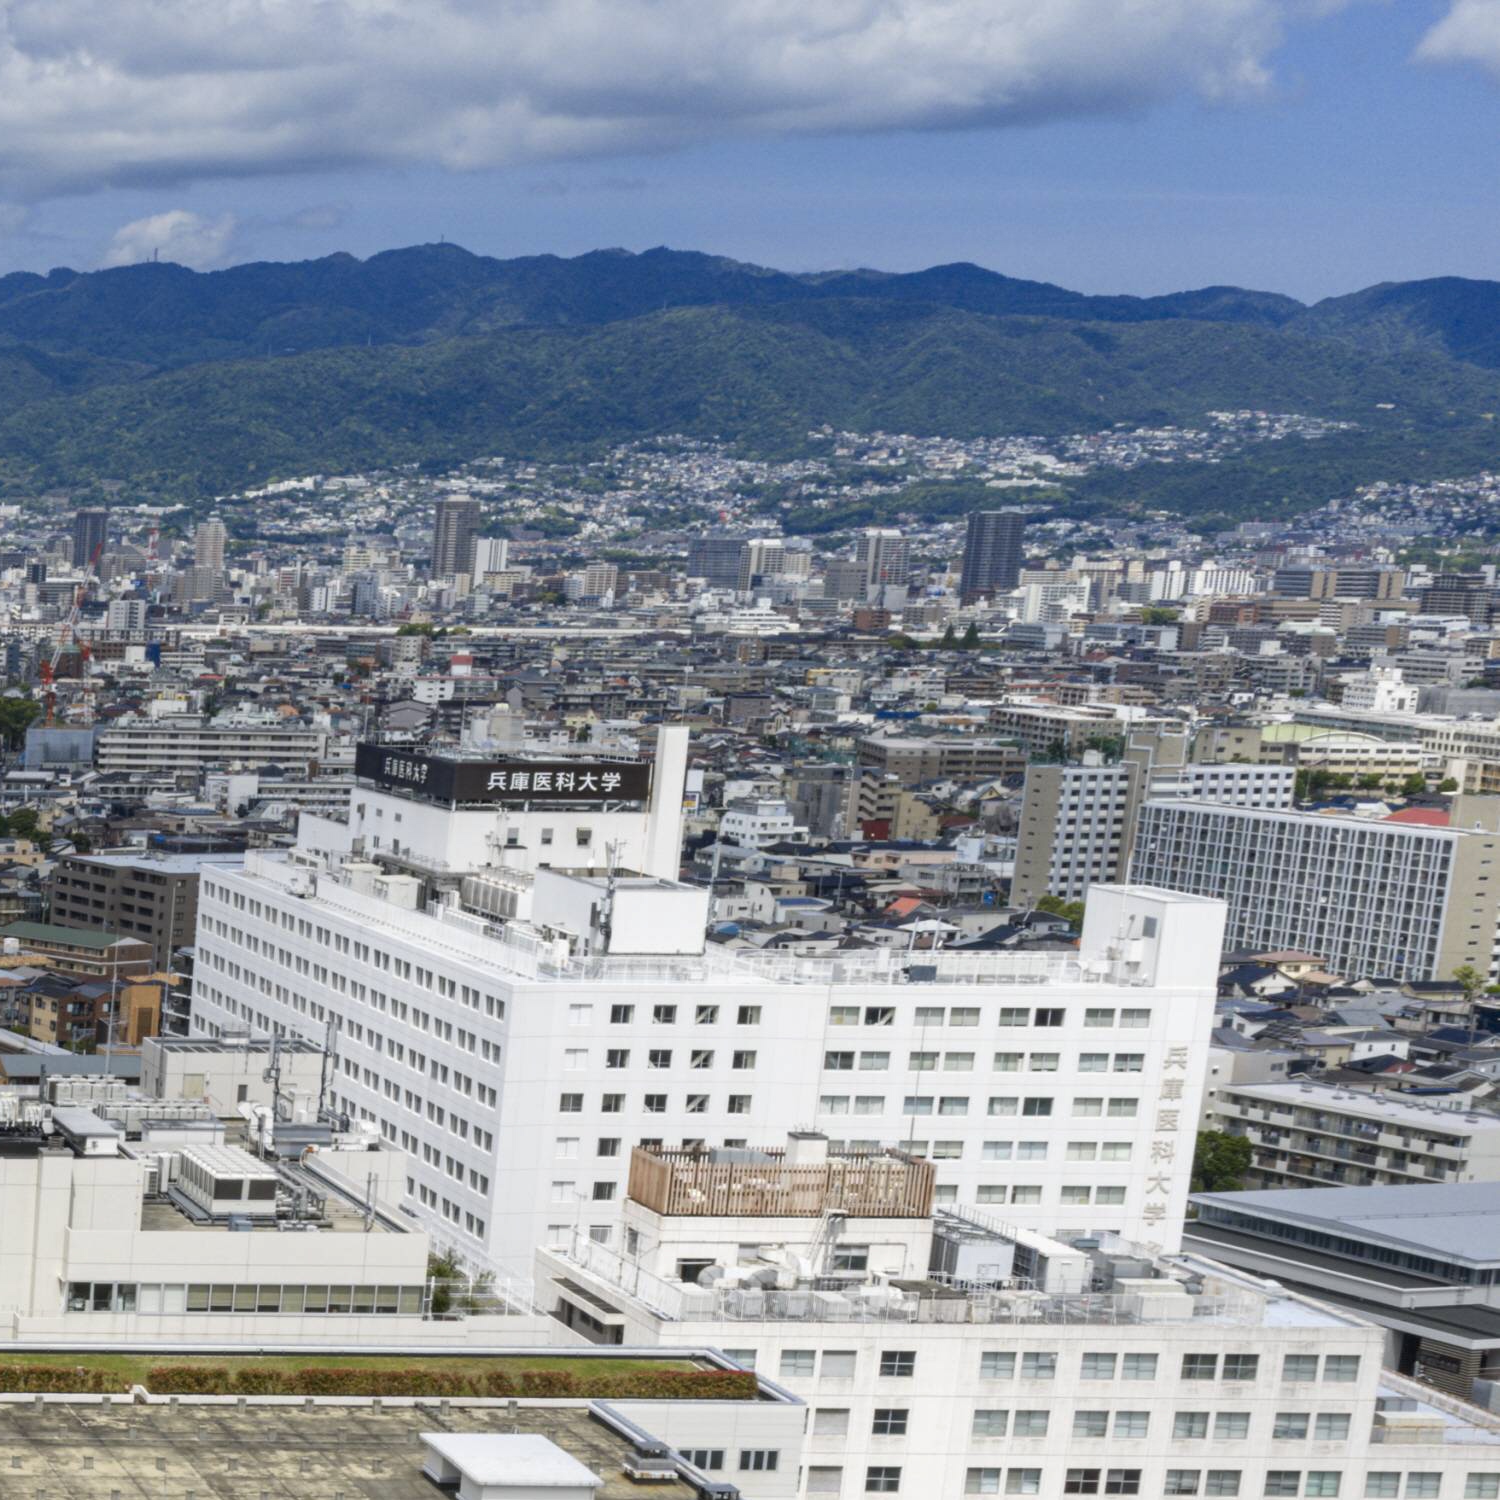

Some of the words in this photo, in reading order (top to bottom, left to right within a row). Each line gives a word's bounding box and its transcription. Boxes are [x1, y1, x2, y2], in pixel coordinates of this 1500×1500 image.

[383, 756, 429, 784] 兵庫医科大学
[487, 771, 622, 792] 兵庫医科大学
